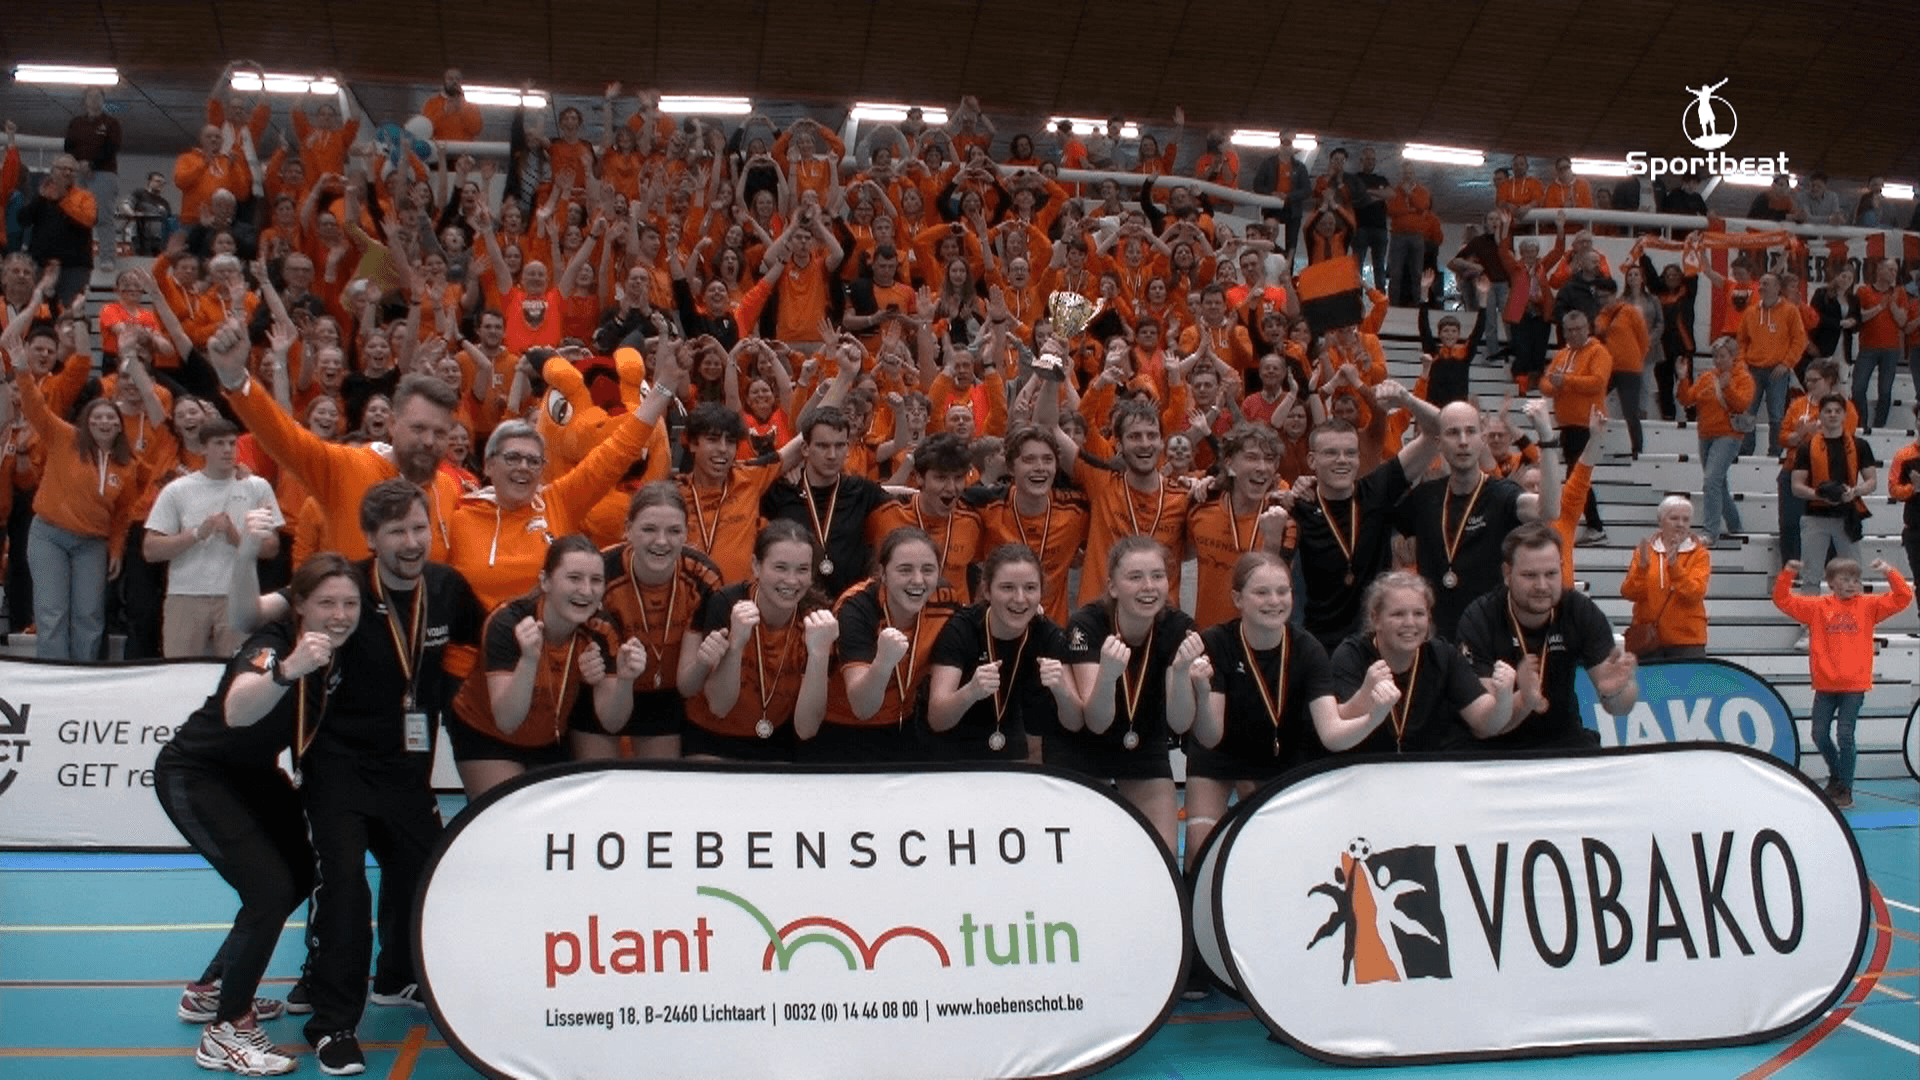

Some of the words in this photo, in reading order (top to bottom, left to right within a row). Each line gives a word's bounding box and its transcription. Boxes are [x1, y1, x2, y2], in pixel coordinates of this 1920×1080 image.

[58, 720, 131, 745] GIVE
[58, 763, 119, 787] GET
[546, 828, 1071, 871] HOEBENSCHOT
[1454, 828, 1804, 971] VOBAKO
[546, 915, 713, 988] plant
[960, 911, 1080, 967] tuin
[546, 1008, 614, 1031] Lisseweg
[703, 1003, 766, 1023] Lichtaart
[784, 1003, 817, 1021] 0032
[821, 1003, 838, 1022] (0)
[843, 1002, 859, 1020] 14
[862, 1001, 879, 1020] 46
[882, 1001, 899, 1019] 08
[902, 1000, 919, 1018] 00
[936, 994, 1084, 1017] www.hoebenschot.be
